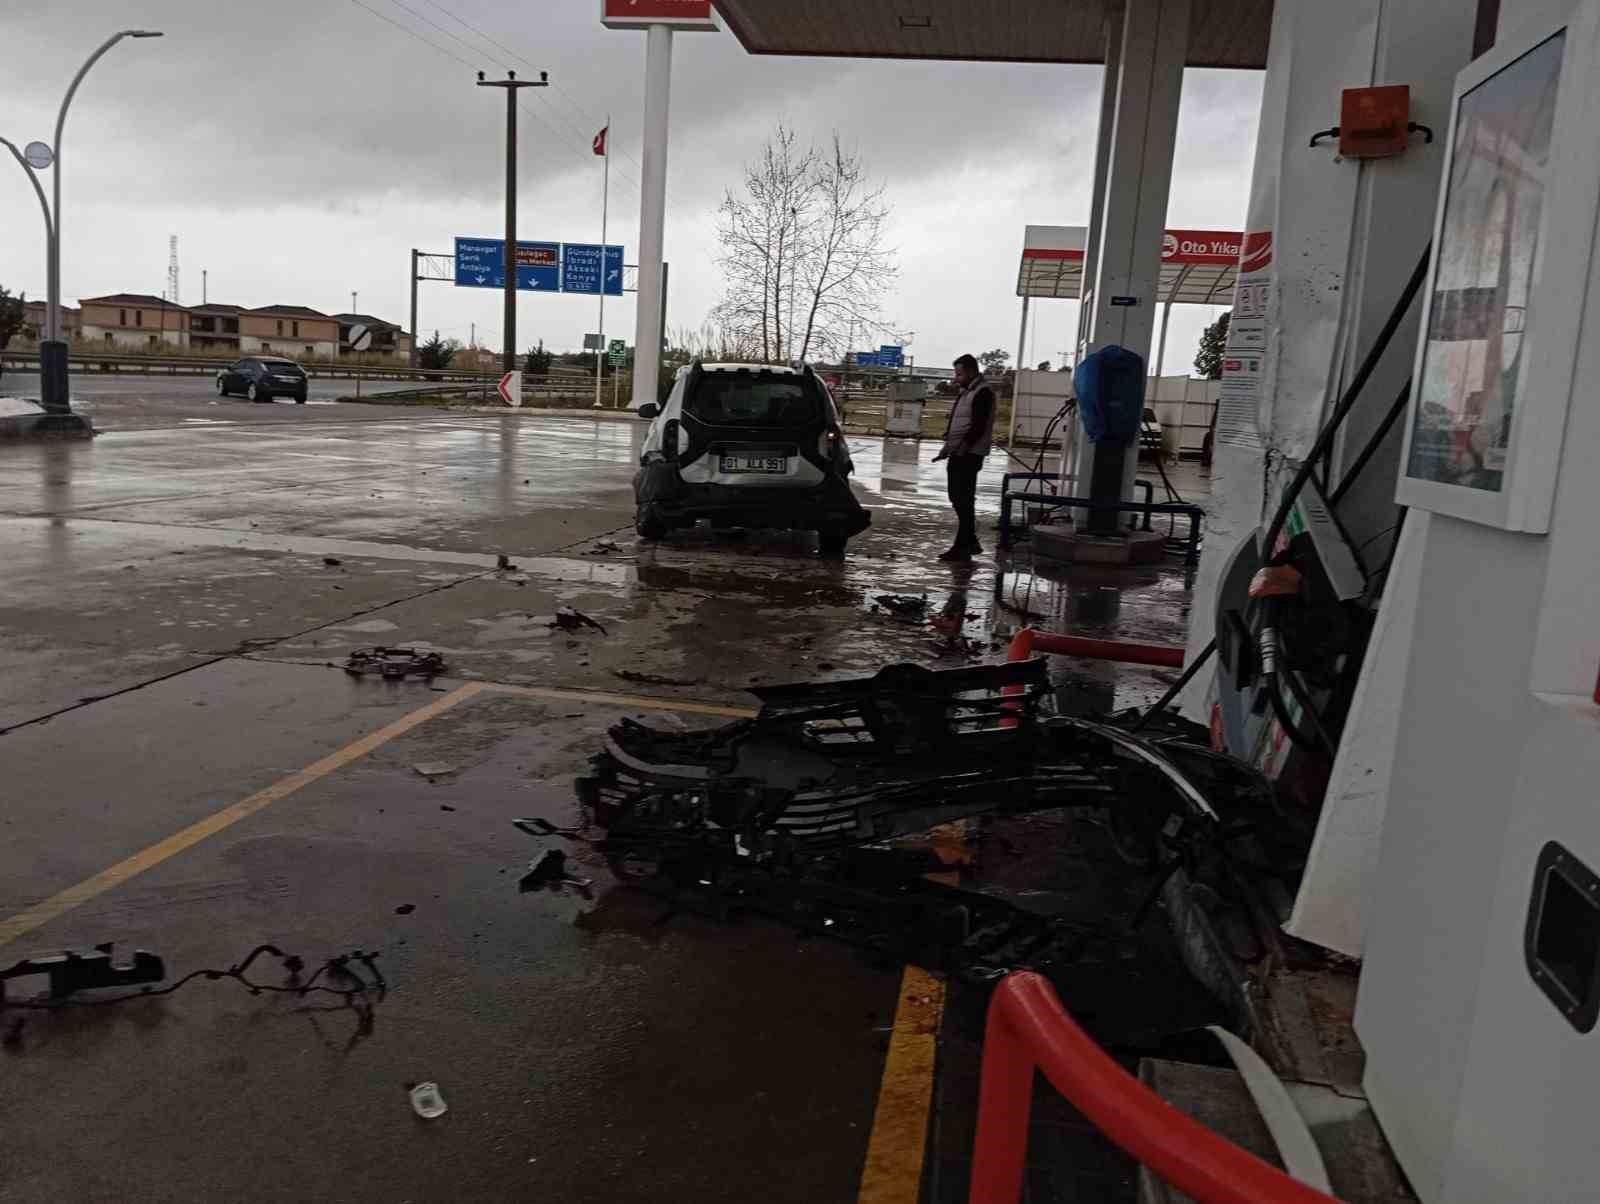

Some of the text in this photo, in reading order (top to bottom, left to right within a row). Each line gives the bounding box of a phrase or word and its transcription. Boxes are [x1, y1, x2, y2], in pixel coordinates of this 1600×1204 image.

[459, 244, 496, 254] Manavgat
[1181, 240, 1240, 255] Oto Yıka
[566, 272, 596, 282] Konya
